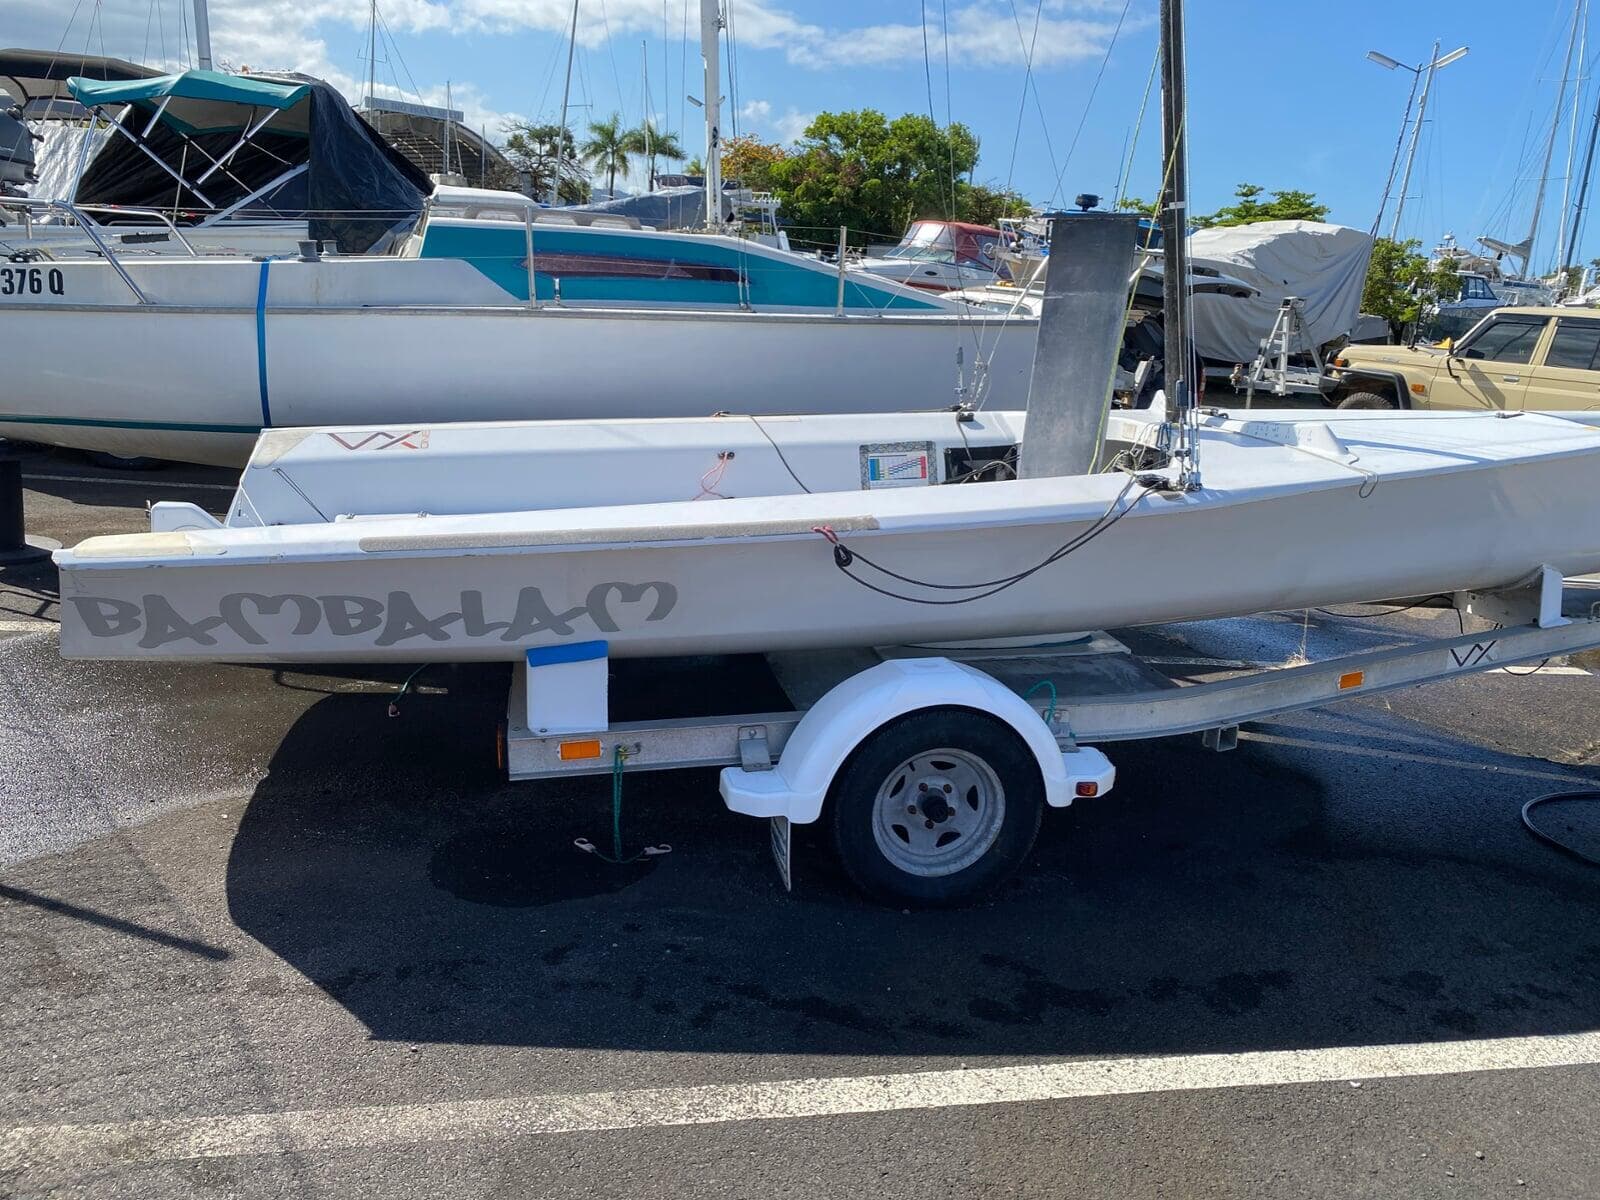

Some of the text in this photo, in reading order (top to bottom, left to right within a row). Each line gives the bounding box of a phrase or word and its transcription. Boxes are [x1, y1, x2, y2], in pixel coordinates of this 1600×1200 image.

[0, 268, 64, 295] 376 Q
[66, 581, 678, 649] BAMBALAM
